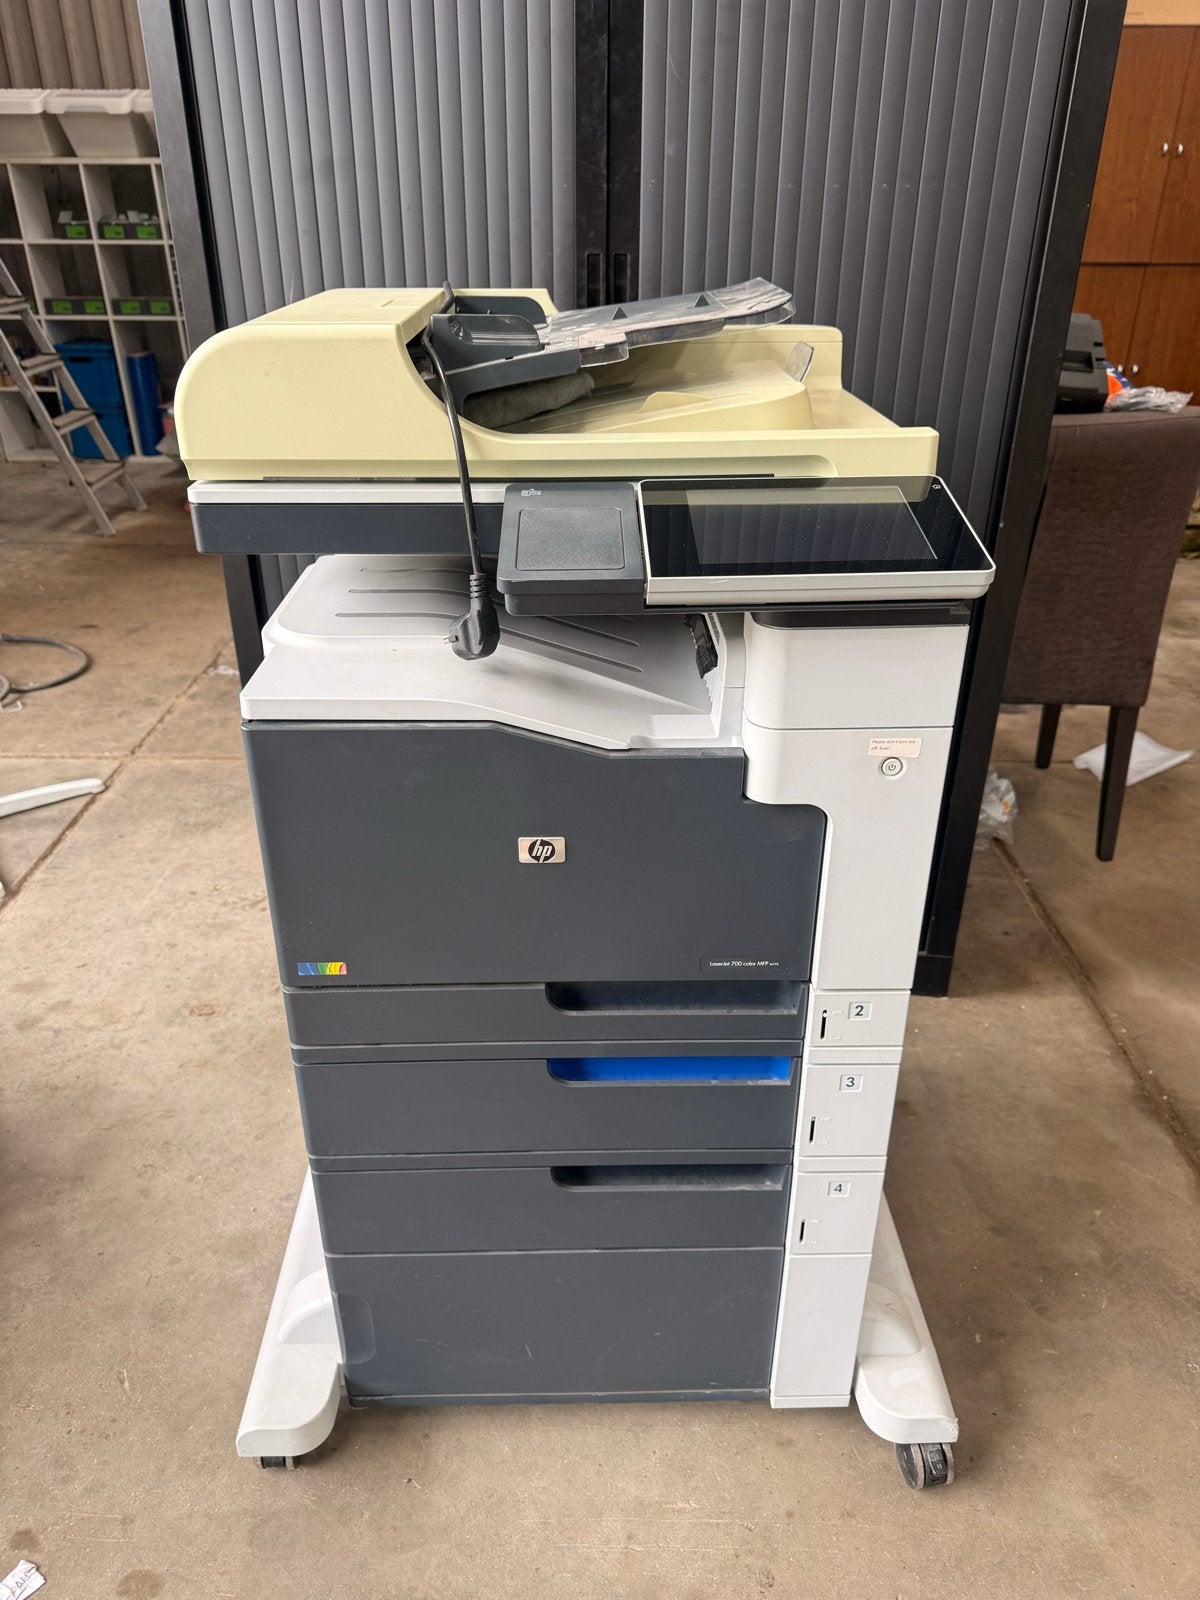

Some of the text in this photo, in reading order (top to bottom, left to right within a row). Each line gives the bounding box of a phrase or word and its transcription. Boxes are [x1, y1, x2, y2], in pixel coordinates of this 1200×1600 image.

[531, 838, 553, 863] hp
[854, 1004, 864, 1017] 2
[846, 1076, 855, 1088] 3
[833, 1183, 843, 1193] 4
